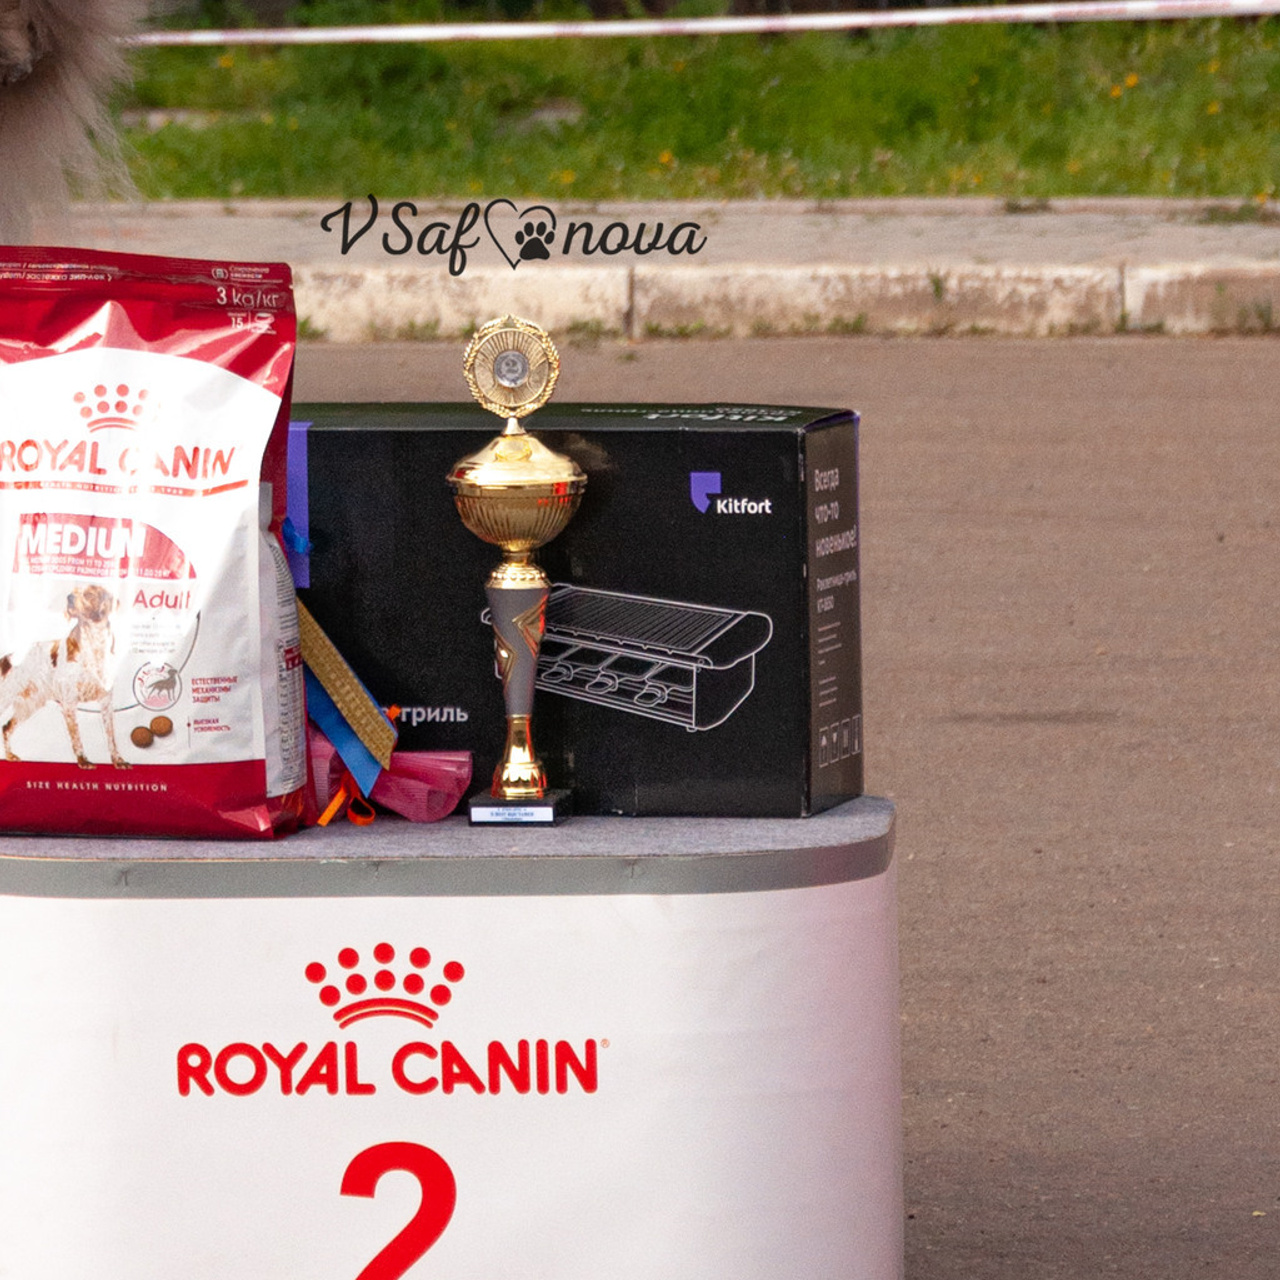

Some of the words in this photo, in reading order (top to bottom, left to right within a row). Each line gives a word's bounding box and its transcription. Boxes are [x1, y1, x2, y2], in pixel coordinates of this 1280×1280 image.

[216, 286, 227, 306] 3
[231, 316, 244, 329] 15
[716, 497, 773, 515] Kitfort
[19, 523, 148, 559] MEDIUM
[133, 589, 191, 610] Adult
[26, 780, 51, 790] SIZE
[56, 781, 99, 791] HEALTH
[105, 782, 169, 793] NUTRITION
[177, 1041, 376, 1096] ROYAL
[339, 1140, 458, 1280] 2
